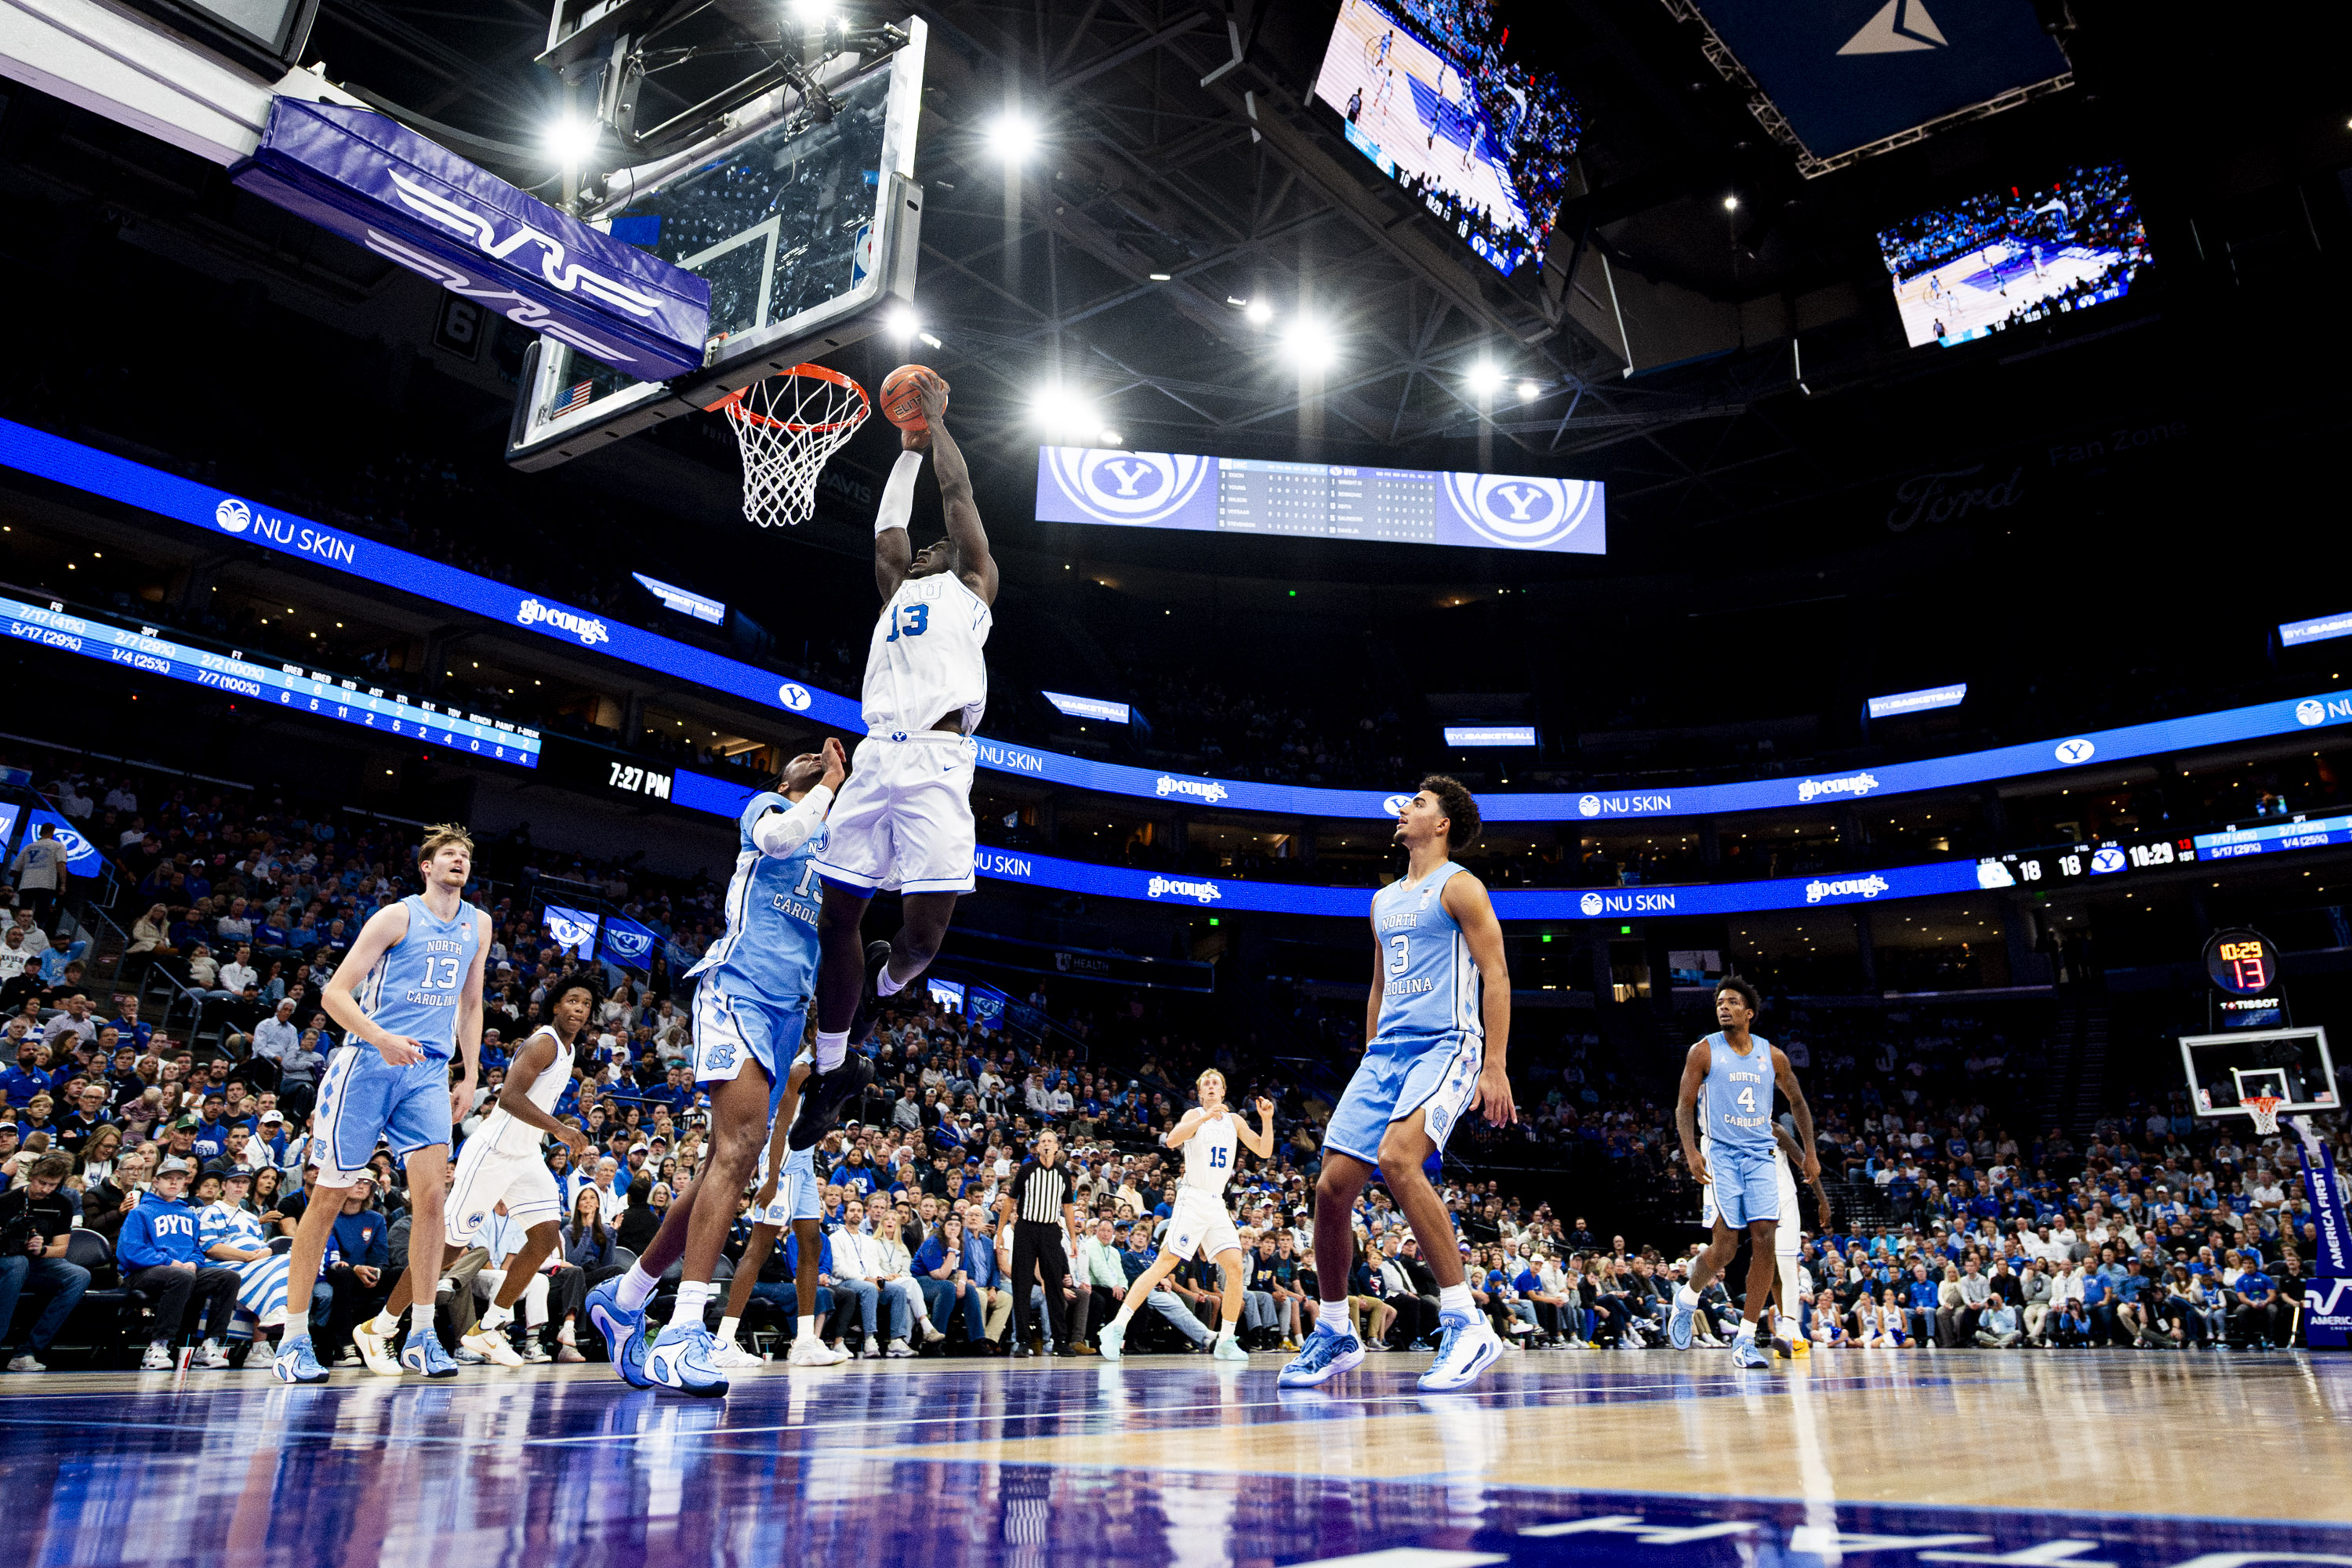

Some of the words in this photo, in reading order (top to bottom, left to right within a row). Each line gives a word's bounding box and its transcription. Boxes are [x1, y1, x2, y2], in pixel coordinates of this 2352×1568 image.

[1399, 170, 1410, 189] 18
[1425, 194, 1443, 216] 10:29
[1457, 220, 1468, 238] 18
[1492, 251, 1506, 270] BYU
[445, 300, 477, 343] 6
[1886, 462, 2025, 532] Ford
[254, 514, 294, 544] NU
[298, 529, 355, 564] SKIN
[19, 605, 49, 622] 7/17
[517, 598, 546, 625] go
[886, 603, 929, 642] 13
[10, 622, 42, 640] 5/17
[43, 630, 82, 652] (29%)
[114, 631, 140, 647] 2/7
[140, 638, 176, 659] (29%)
[111, 648, 132, 663] 1/4
[134, 653, 170, 674] (25%)
[231, 650, 243, 660] FT
[200, 654, 223, 670] 2/2
[224, 660, 265, 681] (100%)
[197, 670, 220, 684] 7/7
[220, 676, 260, 697] (100%)
[368, 687, 384, 698] AST
[396, 694, 408, 705] STL
[786, 687, 805, 706] Y
[281, 691, 291, 703] 6
[310, 699, 318, 710] 5
[338, 706, 348, 718] 11
[365, 713, 374, 725] 2
[392, 720, 401, 731] 5
[418, 727, 427, 738] 2
[444, 733, 452, 744] 4
[471, 740, 479, 751] 0
[495, 746, 503, 757] 8
[519, 753, 528, 764] 4
[980, 745, 1004, 764] NU
[1007, 751, 1043, 773] SKIN
[2063, 742, 2085, 760] Y
[609, 761, 644, 792] 7:27
[644, 771, 671, 800] PM
[1156, 775, 1177, 797] go
[1798, 779, 1822, 801] go
[1603, 797, 1629, 813] NU
[1633, 794, 1671, 811] SKIN
[2178, 839, 2191, 850] 13
[2211, 846, 2233, 858] 5/17
[2282, 837, 2299, 848] 1/4
[2058, 855, 2082, 876] 18
[2129, 842, 2174, 867] 10:29
[994, 855, 1031, 877] SKIN
[2019, 860, 2042, 881] 18
[1147, 876, 1169, 898] go
[1806, 880, 1831, 902] go
[1606, 895, 1632, 912] NU
[1636, 893, 1675, 911] SKIN
[1381, 913, 1417, 931] NORTH
[426, 940, 463, 956] NORTH
[1390, 934, 1410, 975] 3
[2220, 941, 2263, 960] 10:29
[420, 956, 460, 989] 13
[1073, 958, 1109, 971] HEALTH
[2234, 958, 2266, 989] 13
[2235, 998, 2279, 1009] TISSOT
[1729, 1072, 1761, 1084] NORTH
[1737, 1086, 1755, 1112] 4
[1210, 1146, 1227, 1168] 15
[2312, 1172, 2331, 1210] FIRST
[154, 1214, 194, 1237] BYU
[2321, 1209, 2346, 1270] AMERICA
[2310, 1316, 2352, 1325] AMERIC
